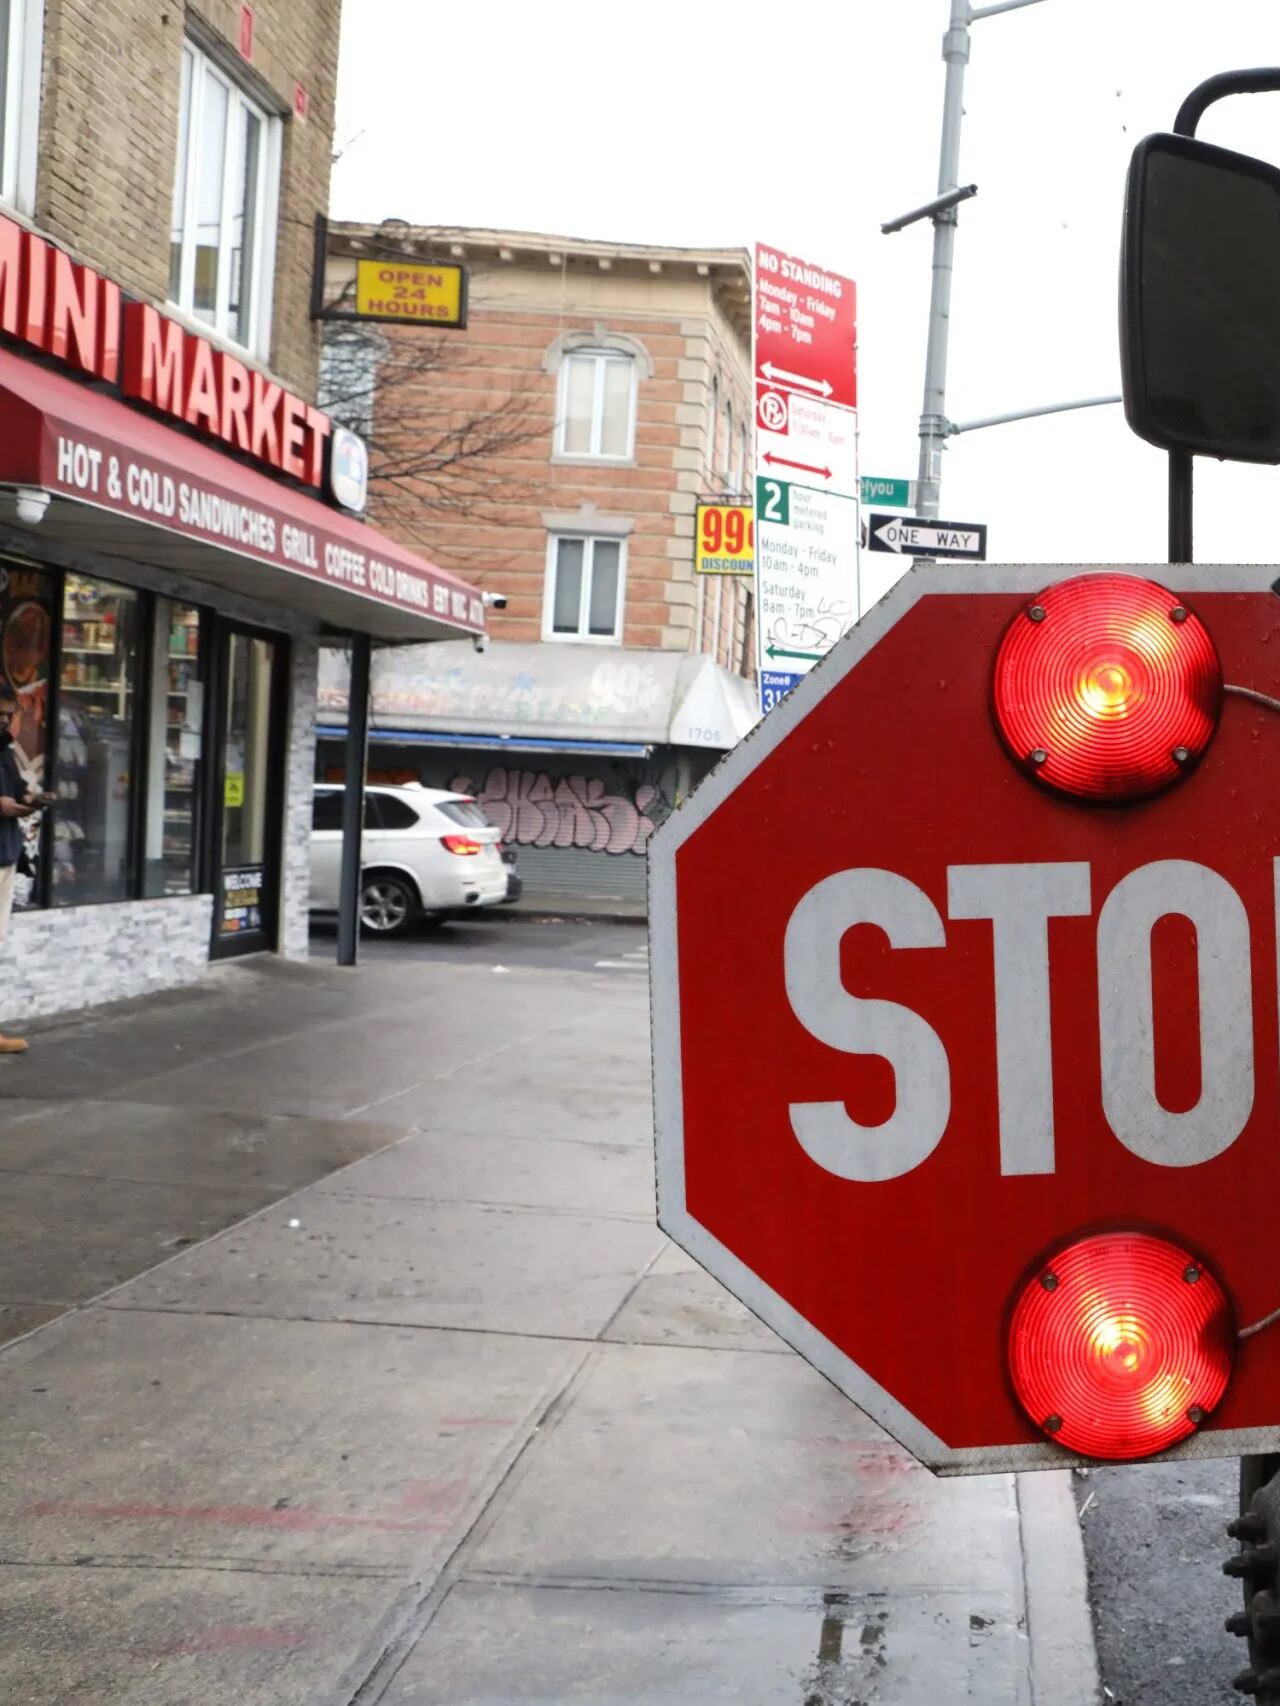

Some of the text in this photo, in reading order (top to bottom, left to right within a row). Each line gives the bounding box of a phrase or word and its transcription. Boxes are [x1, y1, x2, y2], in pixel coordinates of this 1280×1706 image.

[379, 270, 443, 287] OPEN
[760, 249, 842, 299] NO STANDING
[394, 286, 426, 300] 24
[760, 278, 797, 307] Monday
[806, 296, 836, 322] Friday
[368, 299, 449, 317] HOURS
[760, 294, 781, 316] 7am
[790, 307, 815, 329] 10am
[760, 314, 782, 333] 4pm
[791, 323, 813, 344] 7pm
[141, 302, 331, 488] MARKET
[764, 482, 782, 520] 2
[793, 489, 812, 503] hour
[57, 437, 102, 493] HOT
[107, 456, 122, 499] &
[127, 463, 176, 518] COLD
[179, 483, 276, 553] SANDWICHES
[282, 524, 319, 569] GRILL
[325, 543, 366, 586] COFFEE
[369, 560, 395, 596] COLD
[793, 505, 827, 521] metered
[793, 520, 824, 535] parking
[886, 527, 972, 548] ONE WAY
[762, 536, 798, 559] Monday
[808, 546, 837, 566] Friday
[763, 556, 788, 572] 10am
[798, 563, 819, 577] 4pm
[762, 580, 806, 601] Saturday
[762, 598, 784, 614] 8am
[794, 603, 815, 618] 7pm
[764, 689, 790, 712] 31
